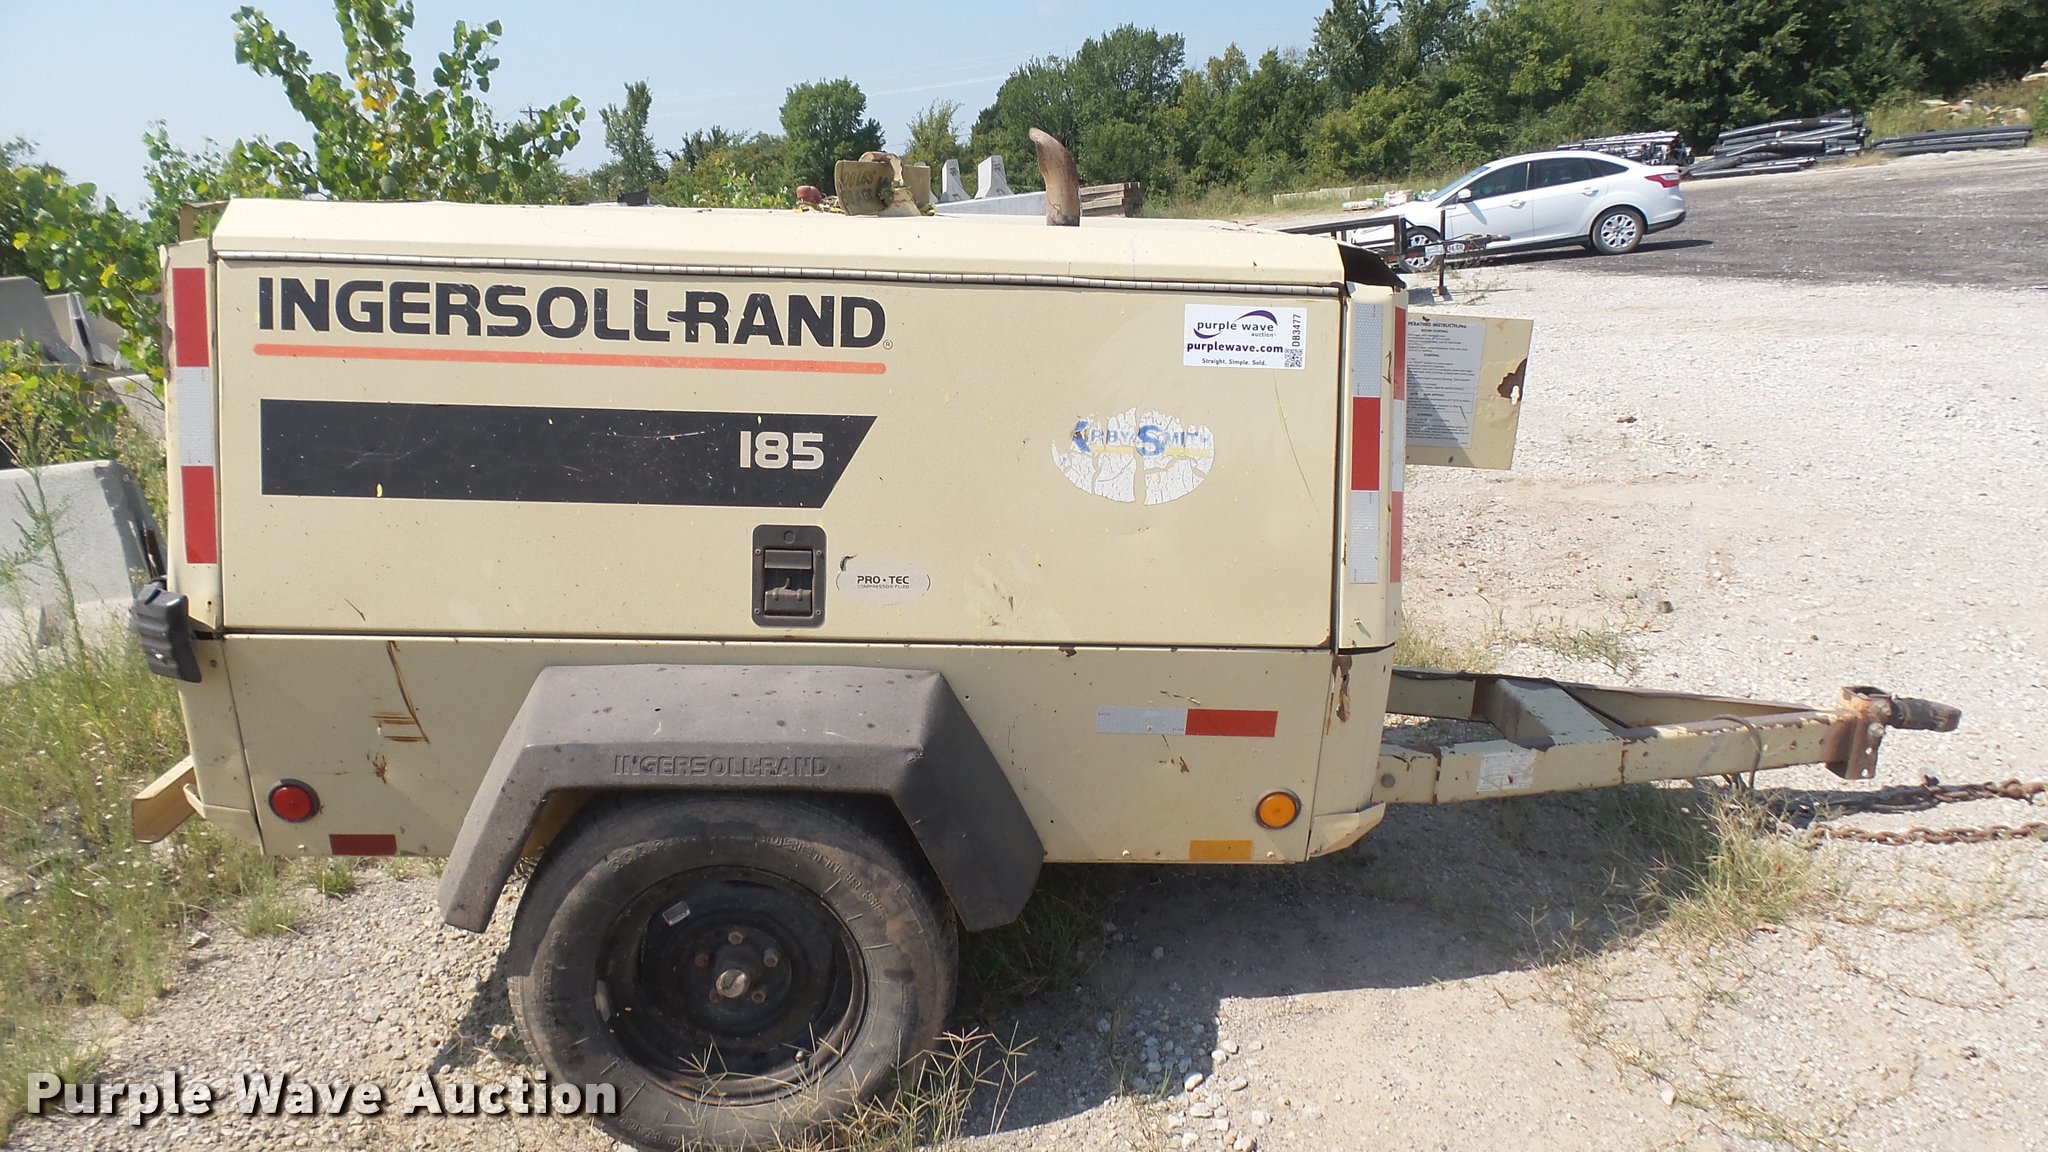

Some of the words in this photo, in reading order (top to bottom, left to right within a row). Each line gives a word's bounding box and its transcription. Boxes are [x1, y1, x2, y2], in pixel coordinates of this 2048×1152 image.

[258, 276, 886, 348] INGERSOLL-RAND
[1197, 321, 1237, 331] purple
[1241, 323, 1274, 332] wave
[1291, 313, 1301, 347] DB3477
[1187, 341, 1284, 353] purplewave.com
[1202, 357, 1227, 365] Straight.
[1229, 358, 1251, 366] Simple.
[740, 430, 824, 470] 185
[614, 755, 830, 777] INGERSOLL-RAND
